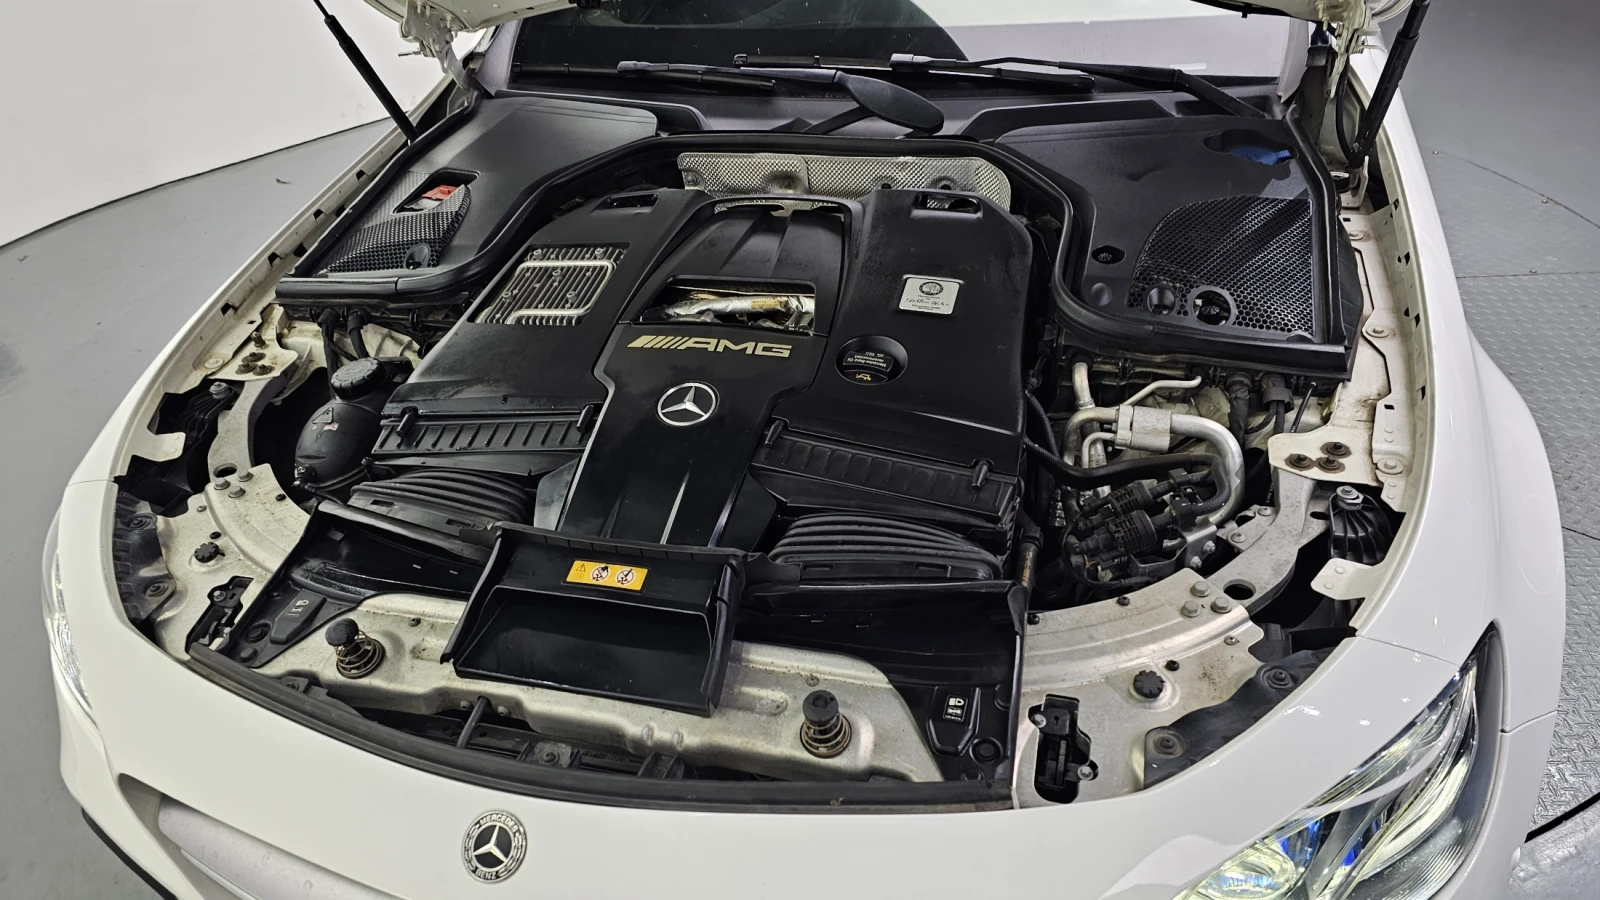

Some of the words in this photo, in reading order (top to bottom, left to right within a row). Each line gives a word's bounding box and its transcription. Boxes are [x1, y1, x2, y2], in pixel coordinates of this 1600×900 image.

[676, 336, 793, 358] AMG
[854, 358, 887, 368] Mercedes-Benz
[479, 813, 519, 833] MERCEDES
[475, 867, 498, 881] BENZ
